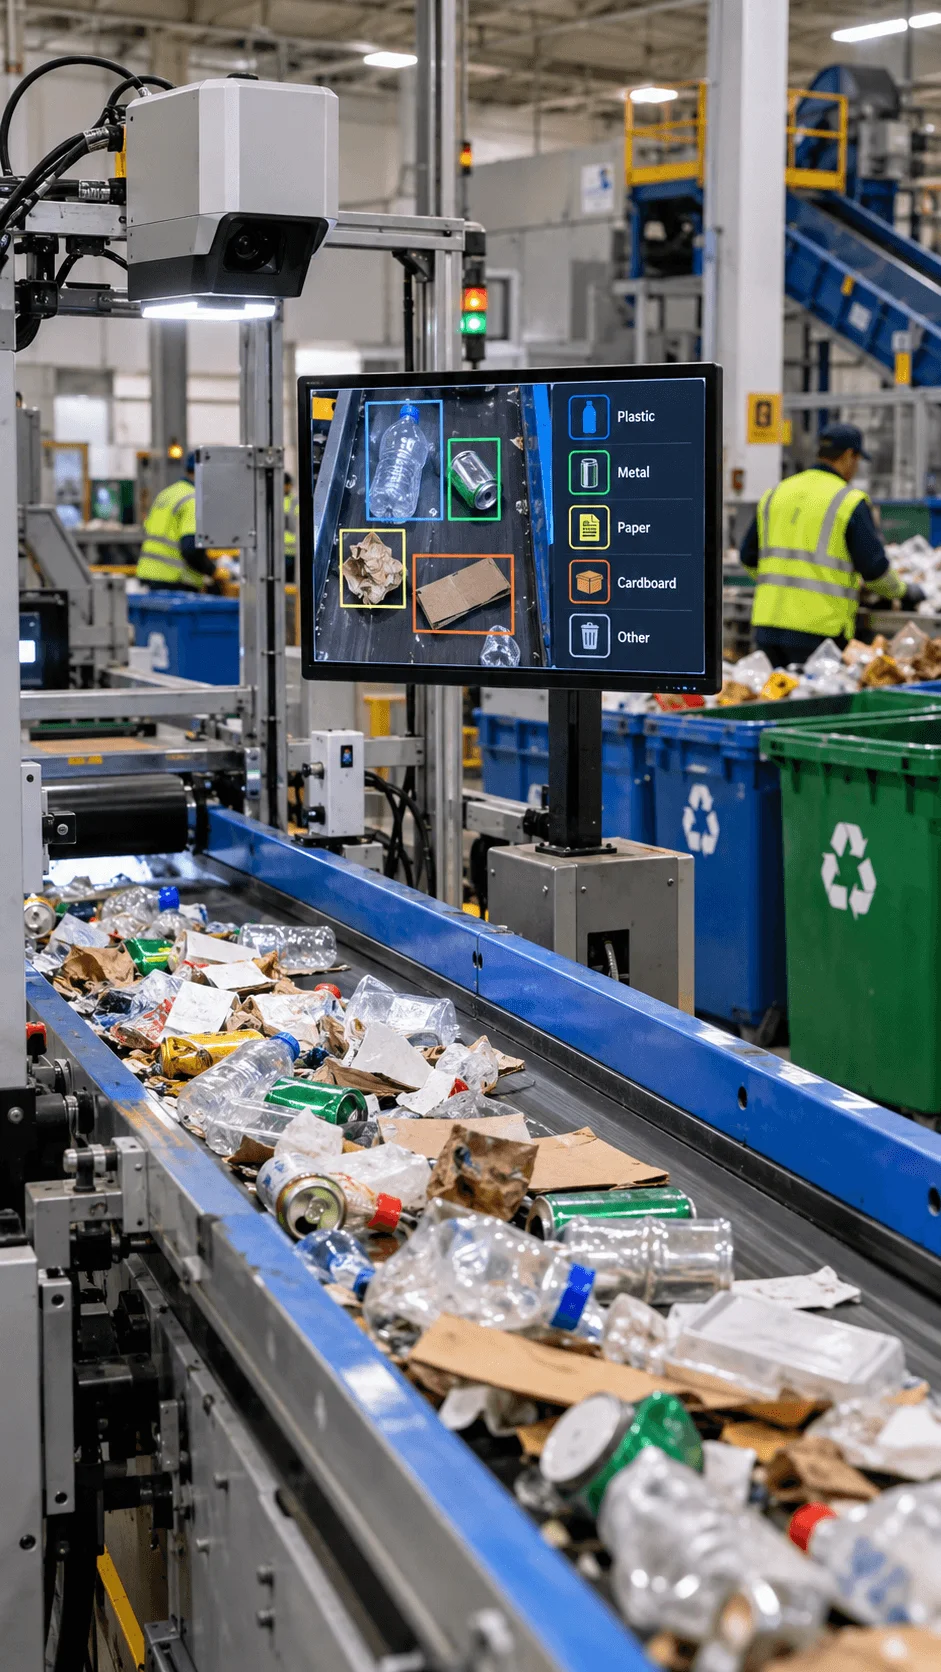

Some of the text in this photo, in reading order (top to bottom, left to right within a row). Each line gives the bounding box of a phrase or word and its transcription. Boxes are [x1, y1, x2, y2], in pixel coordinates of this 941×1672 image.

[617, 410, 656, 423] Plastic
[617, 466, 650, 479] Metal
[617, 522, 651, 536] Paper
[617, 577, 677, 590] Cardboard
[617, 631, 651, 644] Other
